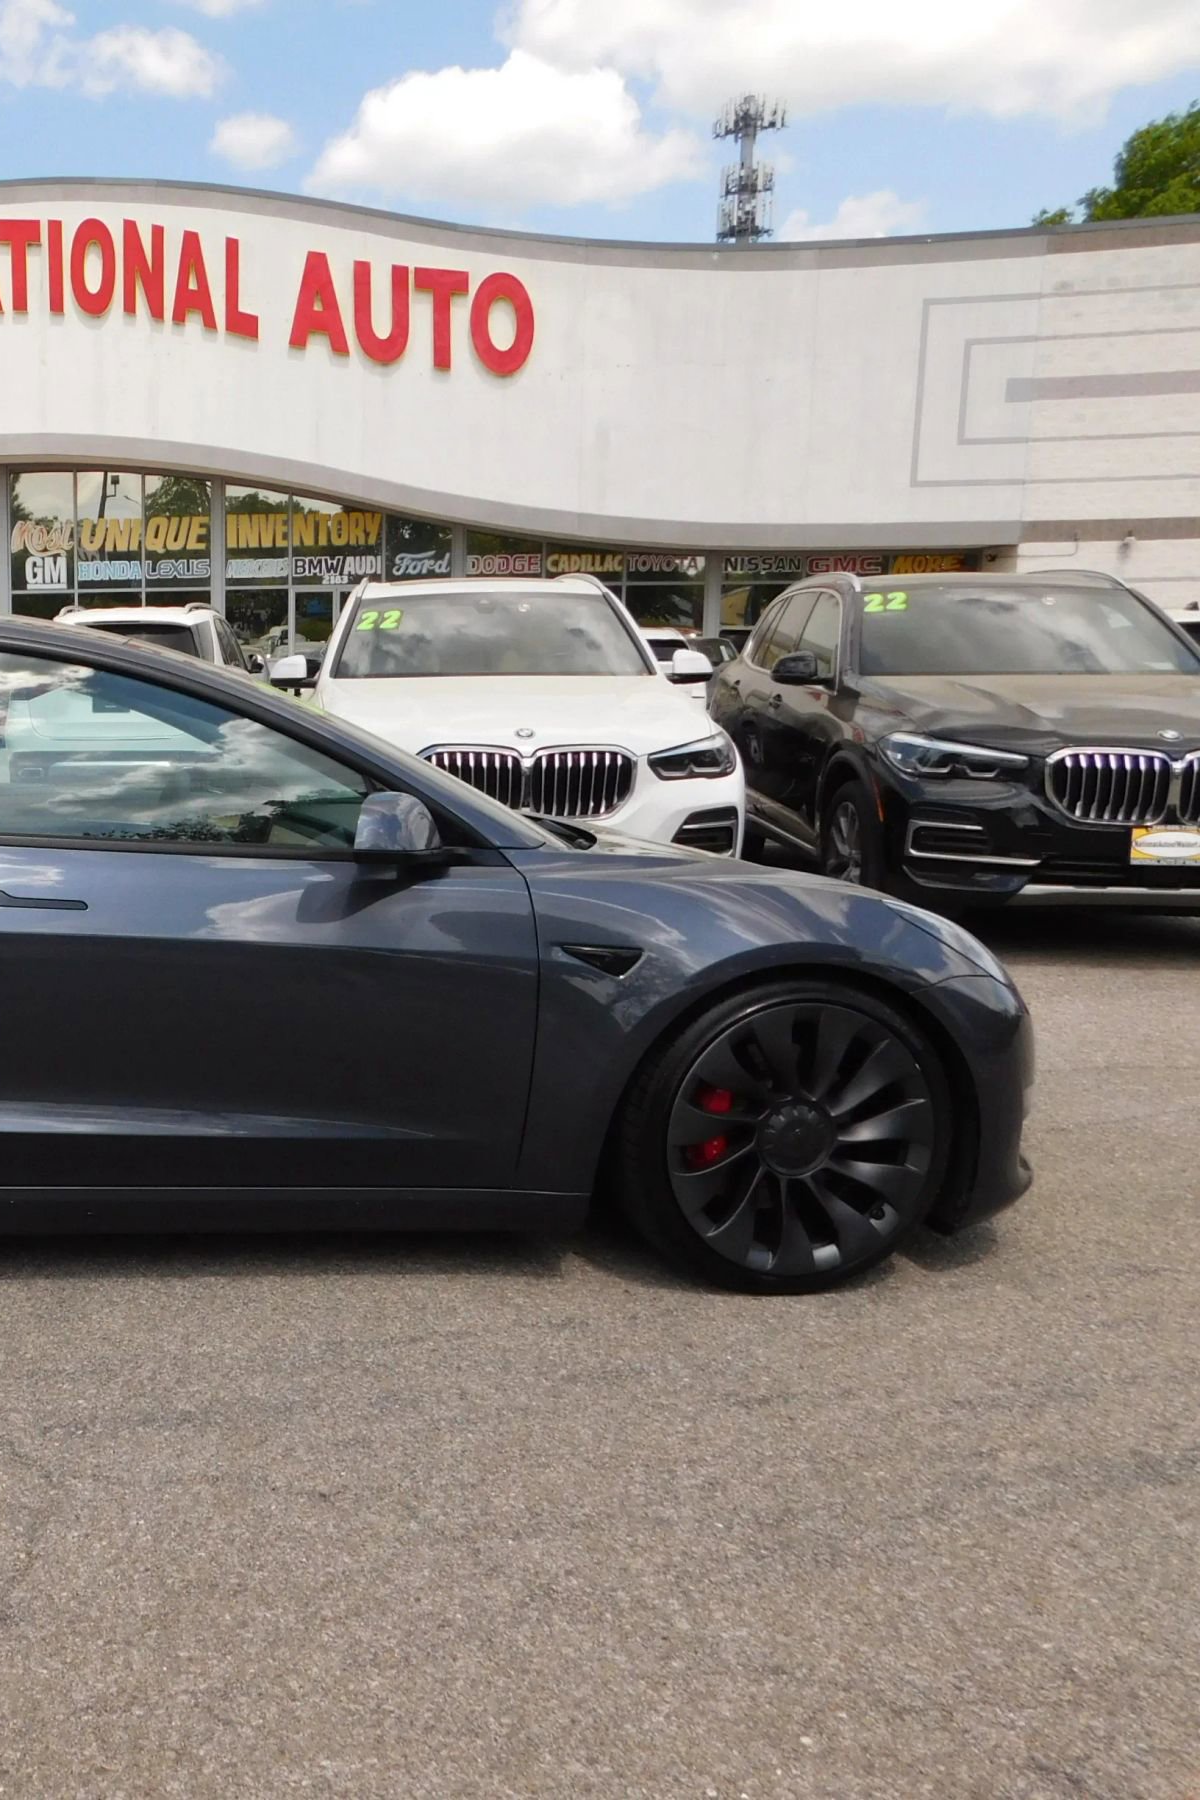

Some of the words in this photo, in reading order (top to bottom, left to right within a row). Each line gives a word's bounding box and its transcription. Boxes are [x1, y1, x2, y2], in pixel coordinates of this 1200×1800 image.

[289, 251, 535, 378] AUTO
[80, 515, 209, 554] UNIQUE
[226, 511, 382, 548] INVENTORY
[25, 556, 67, 586] GM
[78, 560, 142, 580] HONDA
[145, 559, 211, 579] LEXUS
[393, 550, 450, 576] Ford
[467, 554, 541, 574] DODGE
[547, 553, 624, 573] CADILLAC
[628, 554, 702, 573] TOYOTA
[723, 555, 800, 573] NISSAN
[807, 555, 882, 574] GMC
[892, 554, 964, 575] MORE
[863, 592, 908, 612] 22
[356, 610, 402, 631] 22
